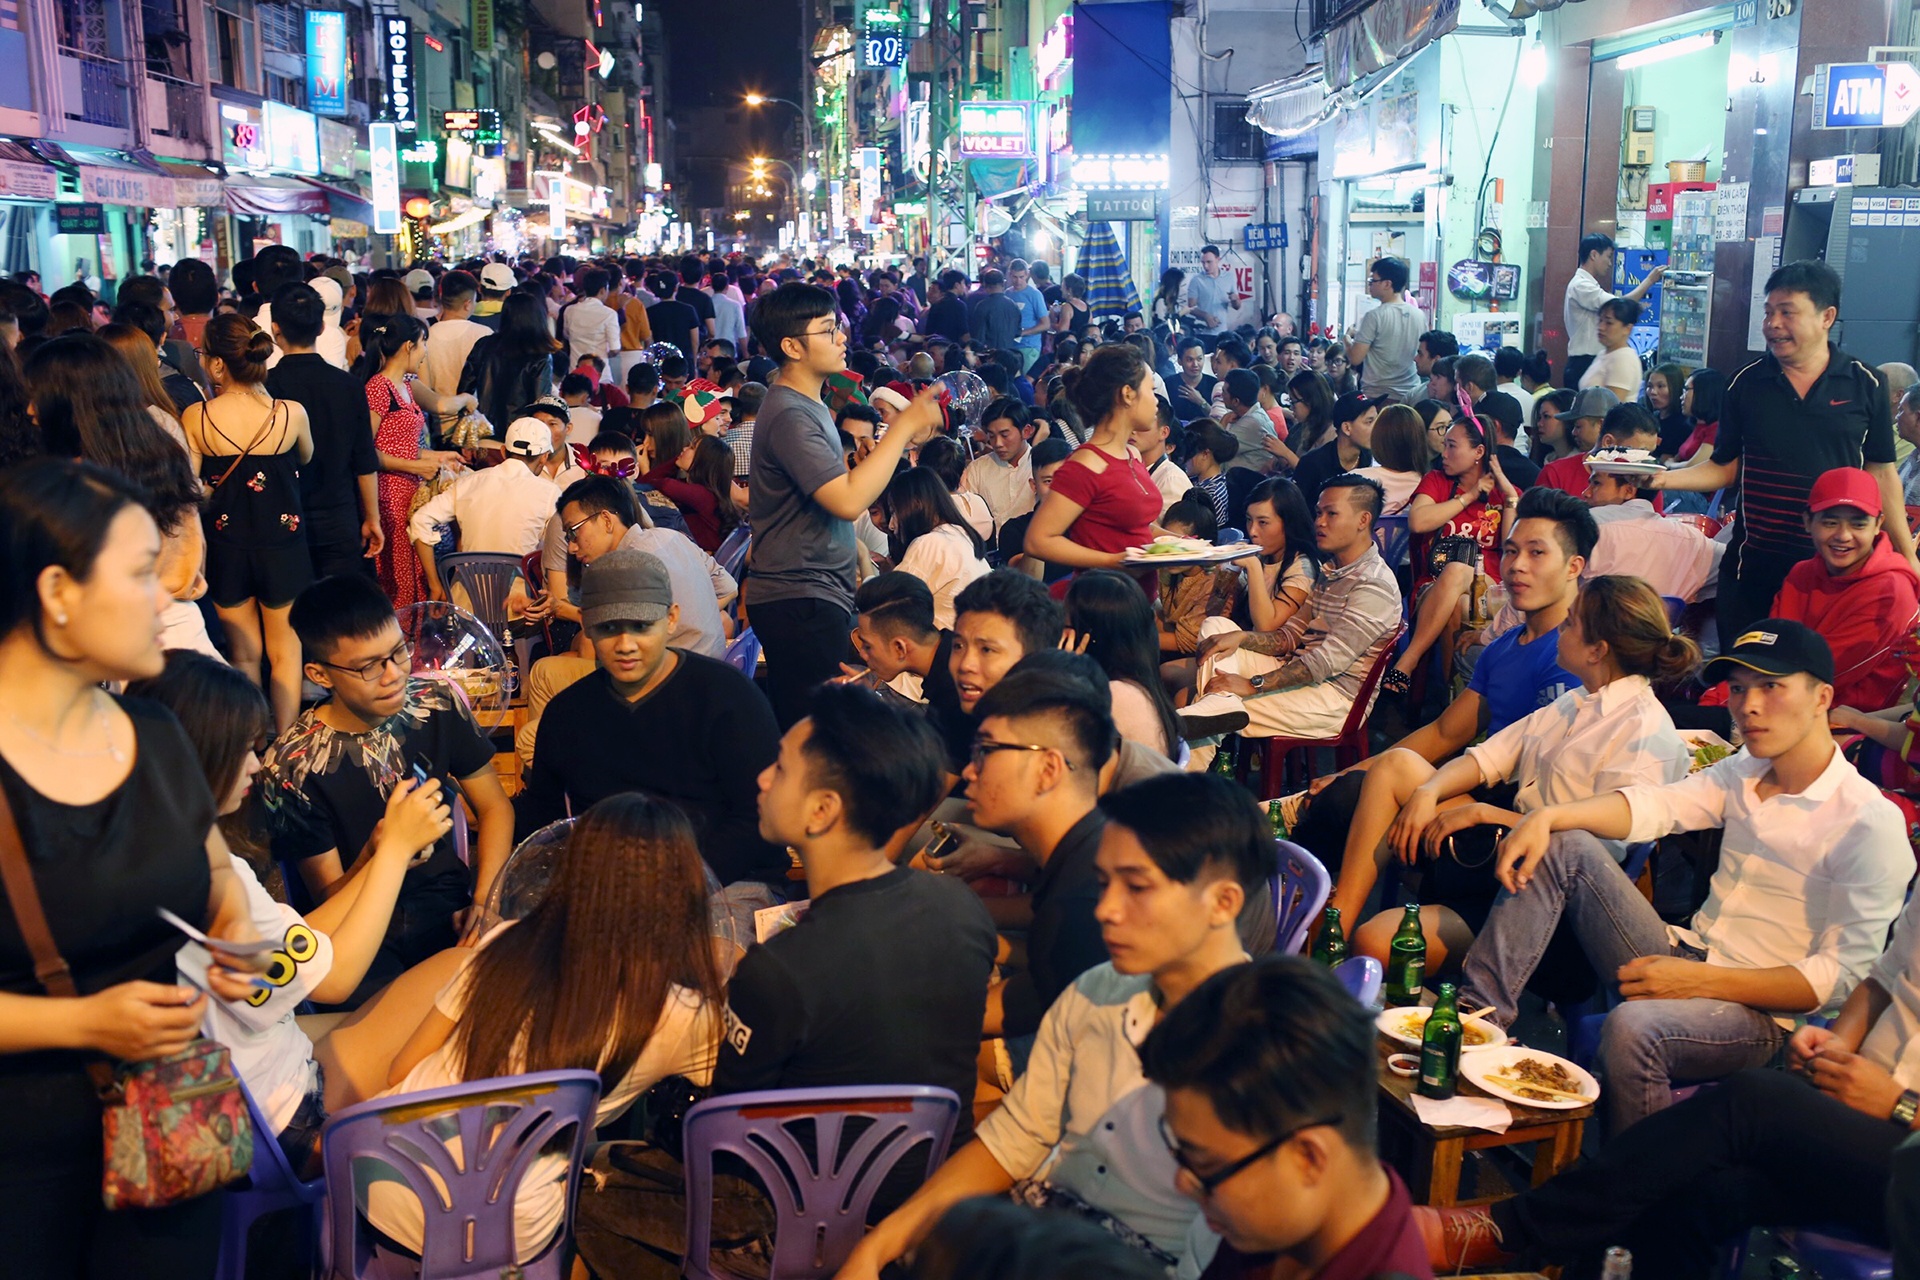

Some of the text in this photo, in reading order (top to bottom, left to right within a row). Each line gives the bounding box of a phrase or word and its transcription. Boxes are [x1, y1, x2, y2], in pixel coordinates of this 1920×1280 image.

[309, 11, 343, 24] Hotel
[1737, 2, 1755, 19] 100
[314, 25, 340, 98] KIM
[1832, 78, 1882, 116] ATM
[235, 124, 257, 149] 89
[963, 136, 1023, 151] VIOLET
[1094, 200, 1151, 212] TATTOO
[1269, 227, 1281, 239] 104
[1170, 251, 1180, 264] CHO
[1180, 247, 1193, 264] THUÊ
[1235, 268, 1253, 292] XE
